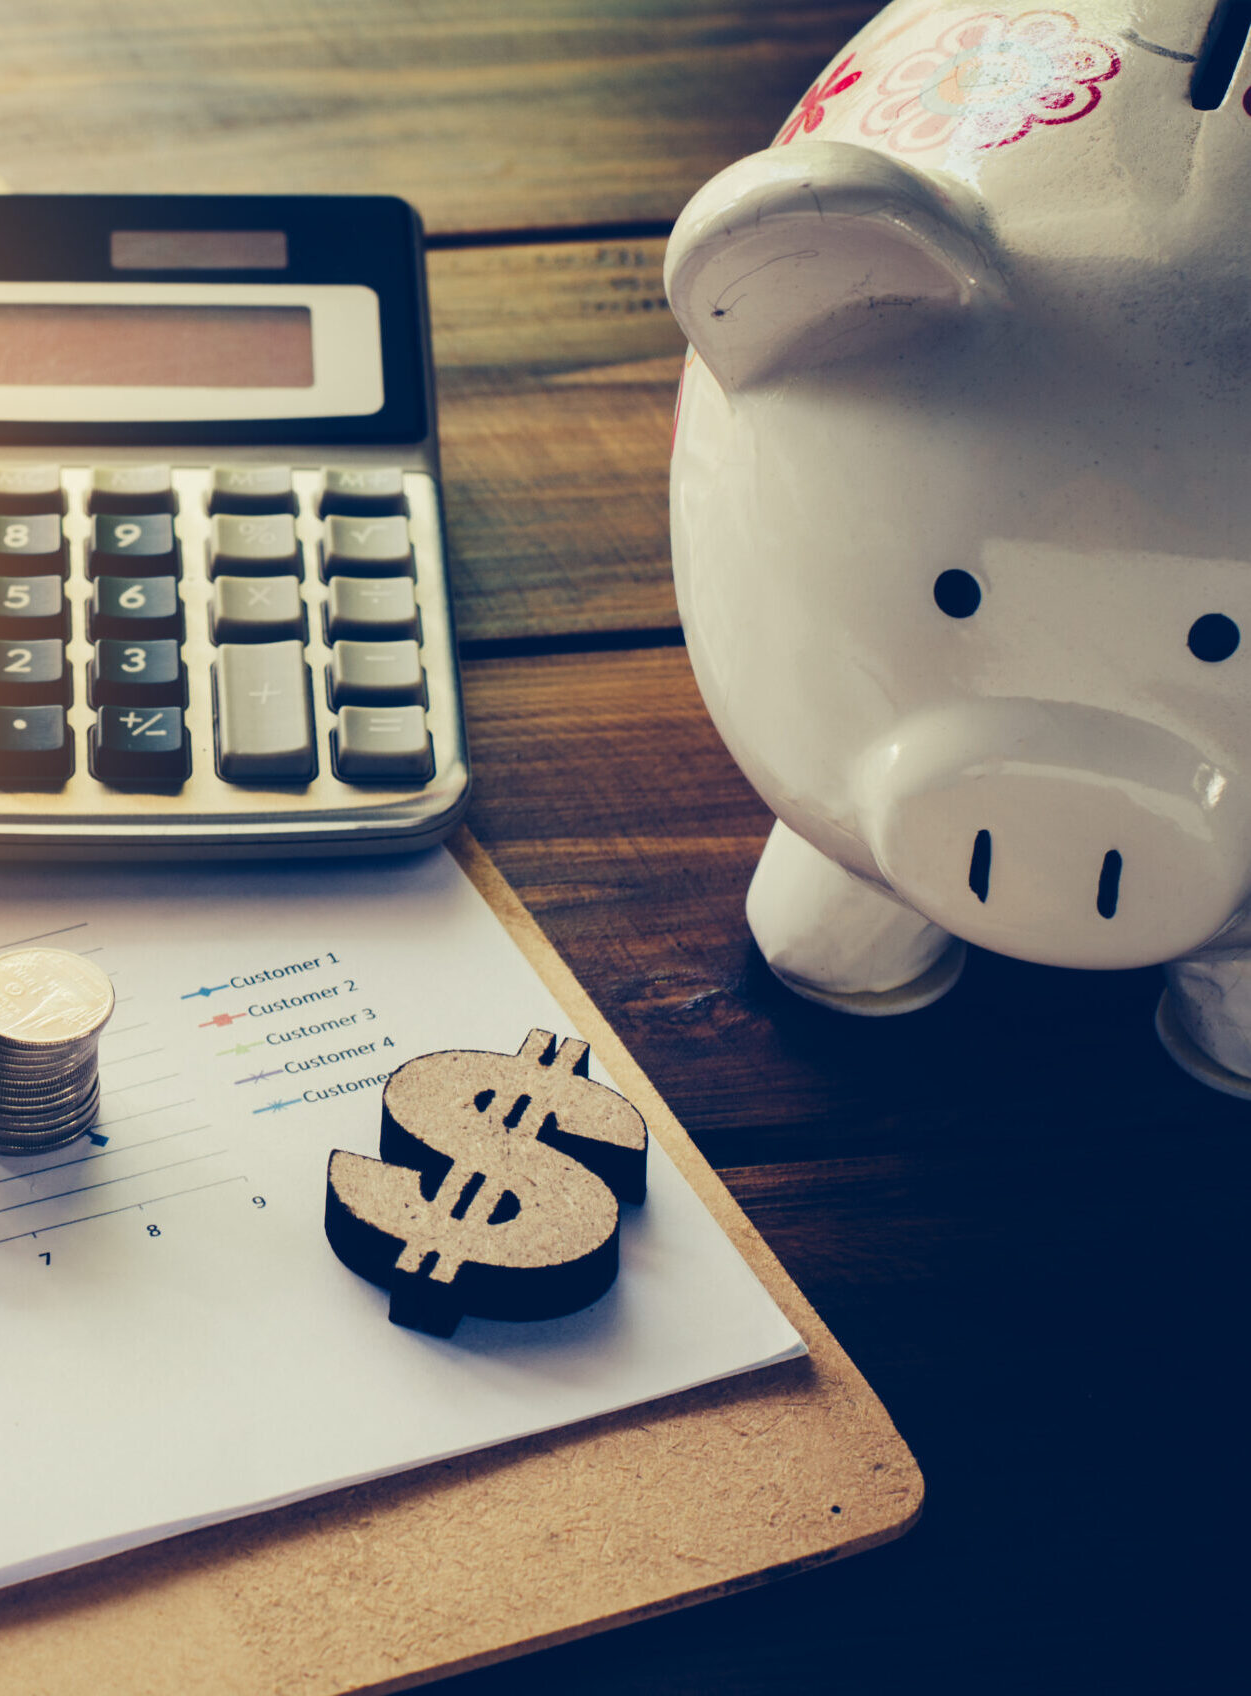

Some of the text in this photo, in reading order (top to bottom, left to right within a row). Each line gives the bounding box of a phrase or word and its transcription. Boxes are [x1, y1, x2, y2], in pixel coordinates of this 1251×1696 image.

[3, 524, 29, 548] 8
[114, 523, 142, 548] 9
[3, 585, 31, 609] 5
[119, 585, 146, 609] 6
[3, 649, 33, 673] 2
[121, 648, 147, 673] 3
[230, 952, 341, 989] Customer 1
[248, 979, 359, 1017] Customer 2
[266, 1008, 377, 1046] Customer 3
[284, 1036, 396, 1074] Customer 4
[252, 1196, 267, 1209] 9
[146, 1224, 161, 1238] 8
[38, 1252, 51, 1266] 7
